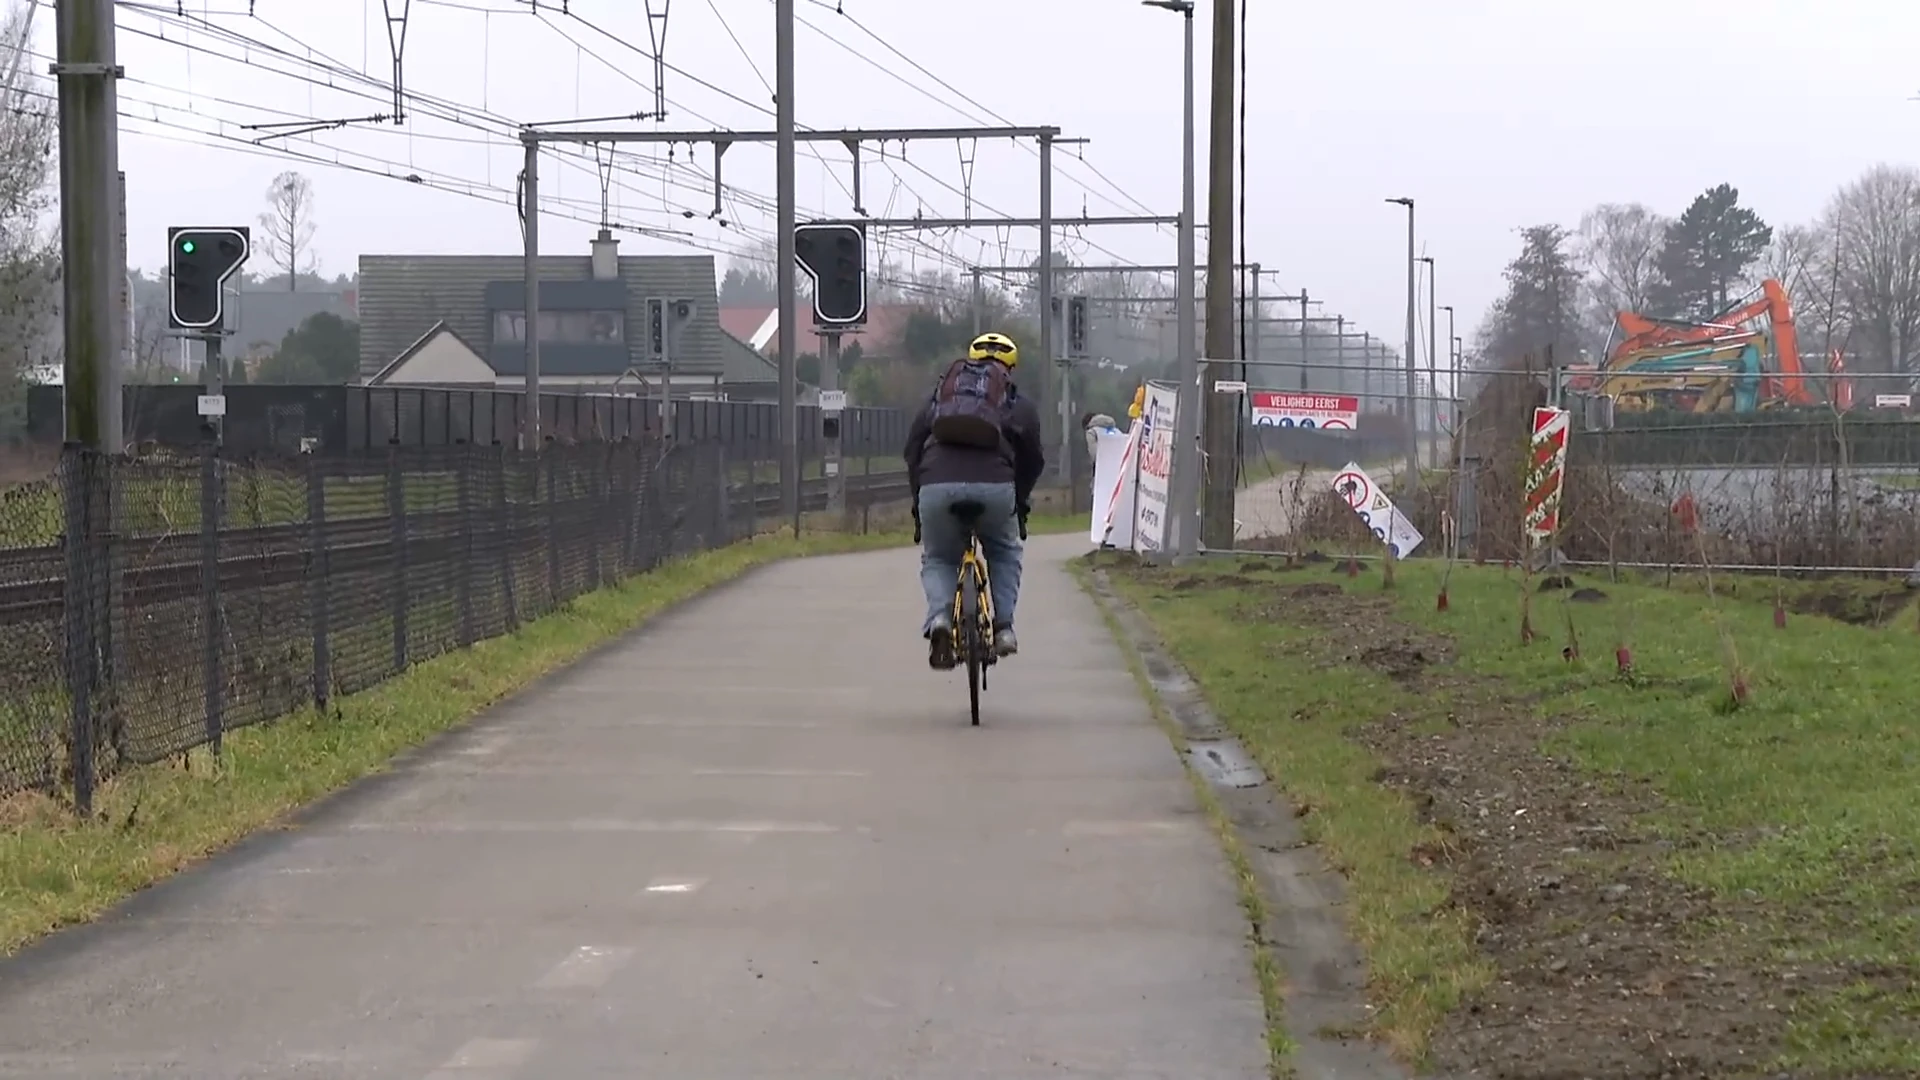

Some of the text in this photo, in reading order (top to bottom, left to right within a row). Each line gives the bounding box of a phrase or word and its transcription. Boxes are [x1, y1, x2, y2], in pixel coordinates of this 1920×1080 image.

[1703, 312, 1749, 336] VEHUUR
[1270, 395, 1340, 409] VEILIGHEID EERST
